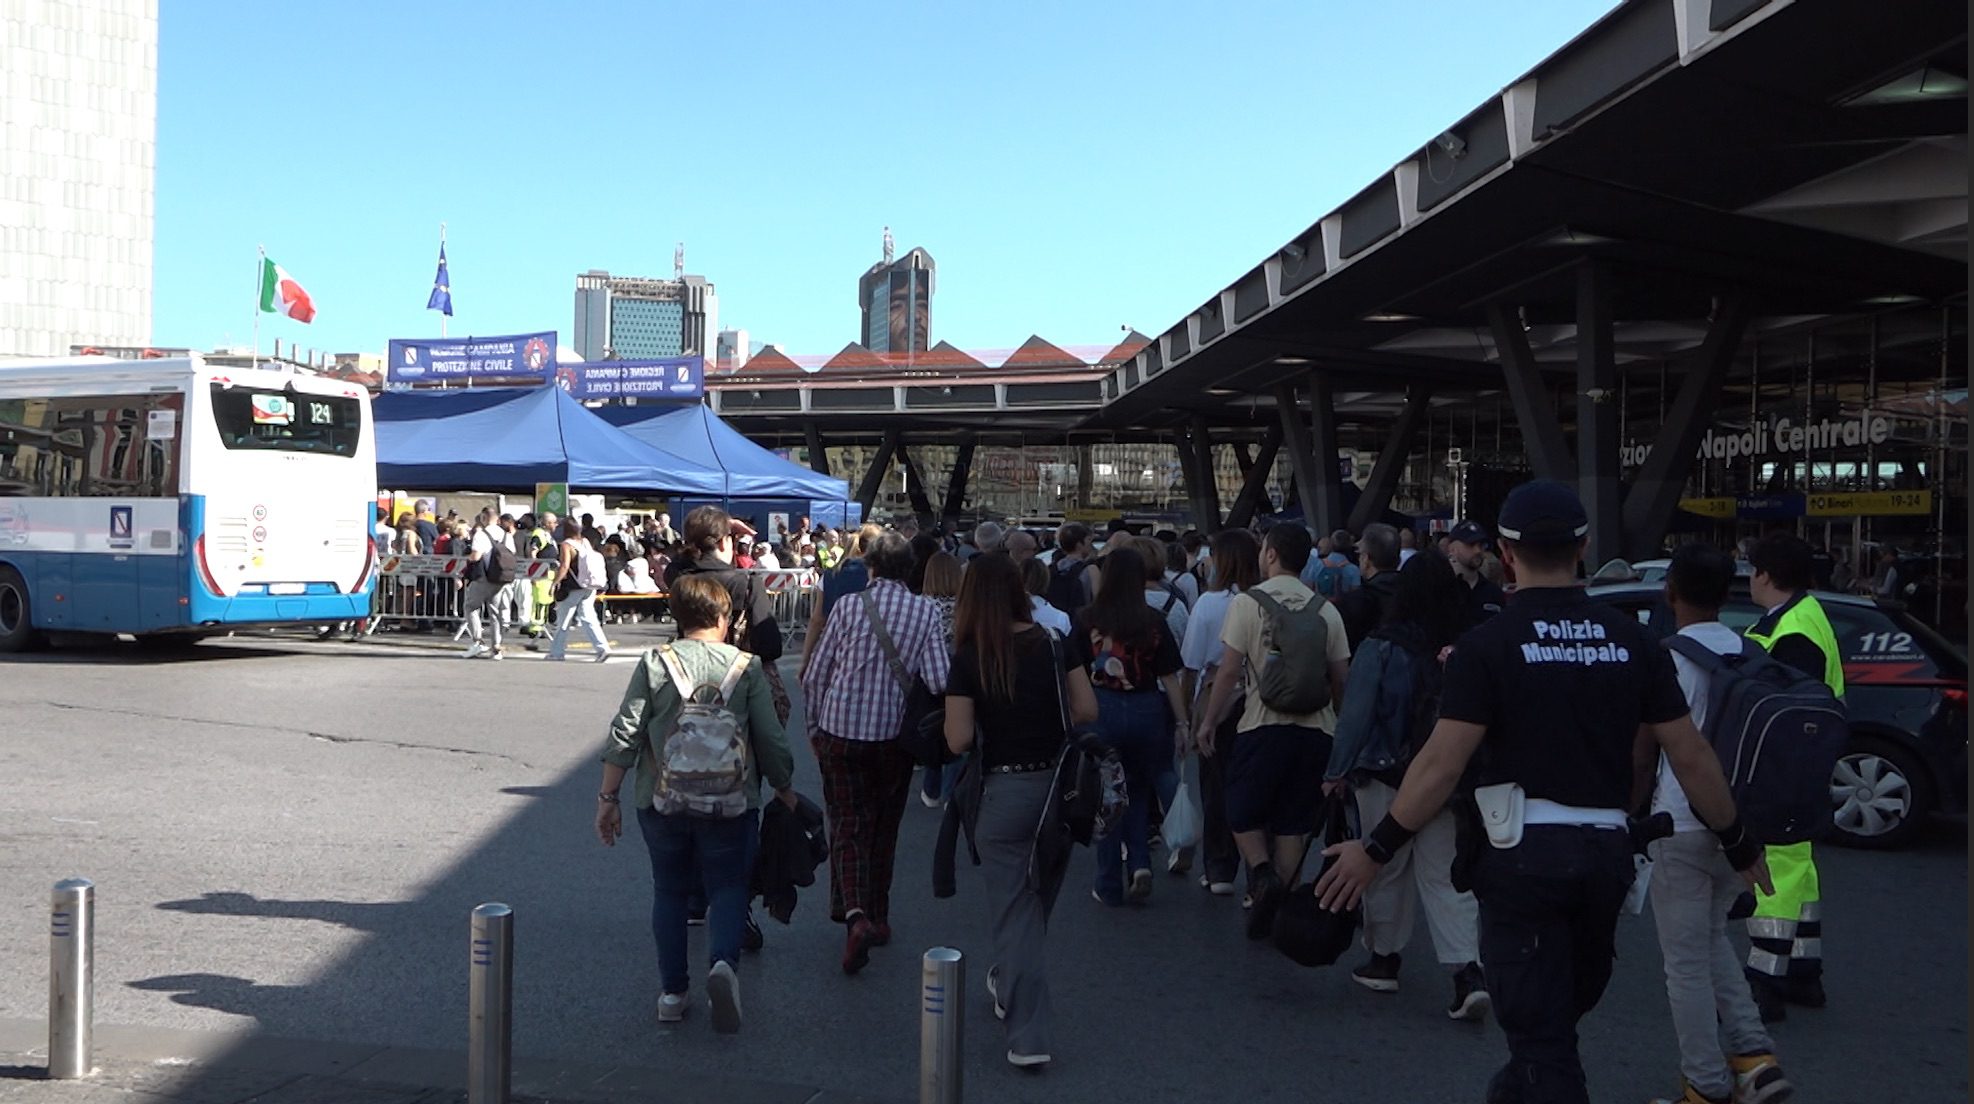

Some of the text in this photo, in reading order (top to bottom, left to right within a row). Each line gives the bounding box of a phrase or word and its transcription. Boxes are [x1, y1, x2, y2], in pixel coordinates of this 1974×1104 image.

[432, 359, 514, 373] PROTEZINE CIVILE
[310, 402, 332, 424] 124
[1696, 419, 1768, 469] Napoli
[1773, 408, 1888, 453] Centrale
[1890, 495, 1921, 507] 19-24
[1532, 619, 1607, 639] Polizia
[1859, 631, 1913, 653] 112
[1520, 642, 1630, 666] Municipale
